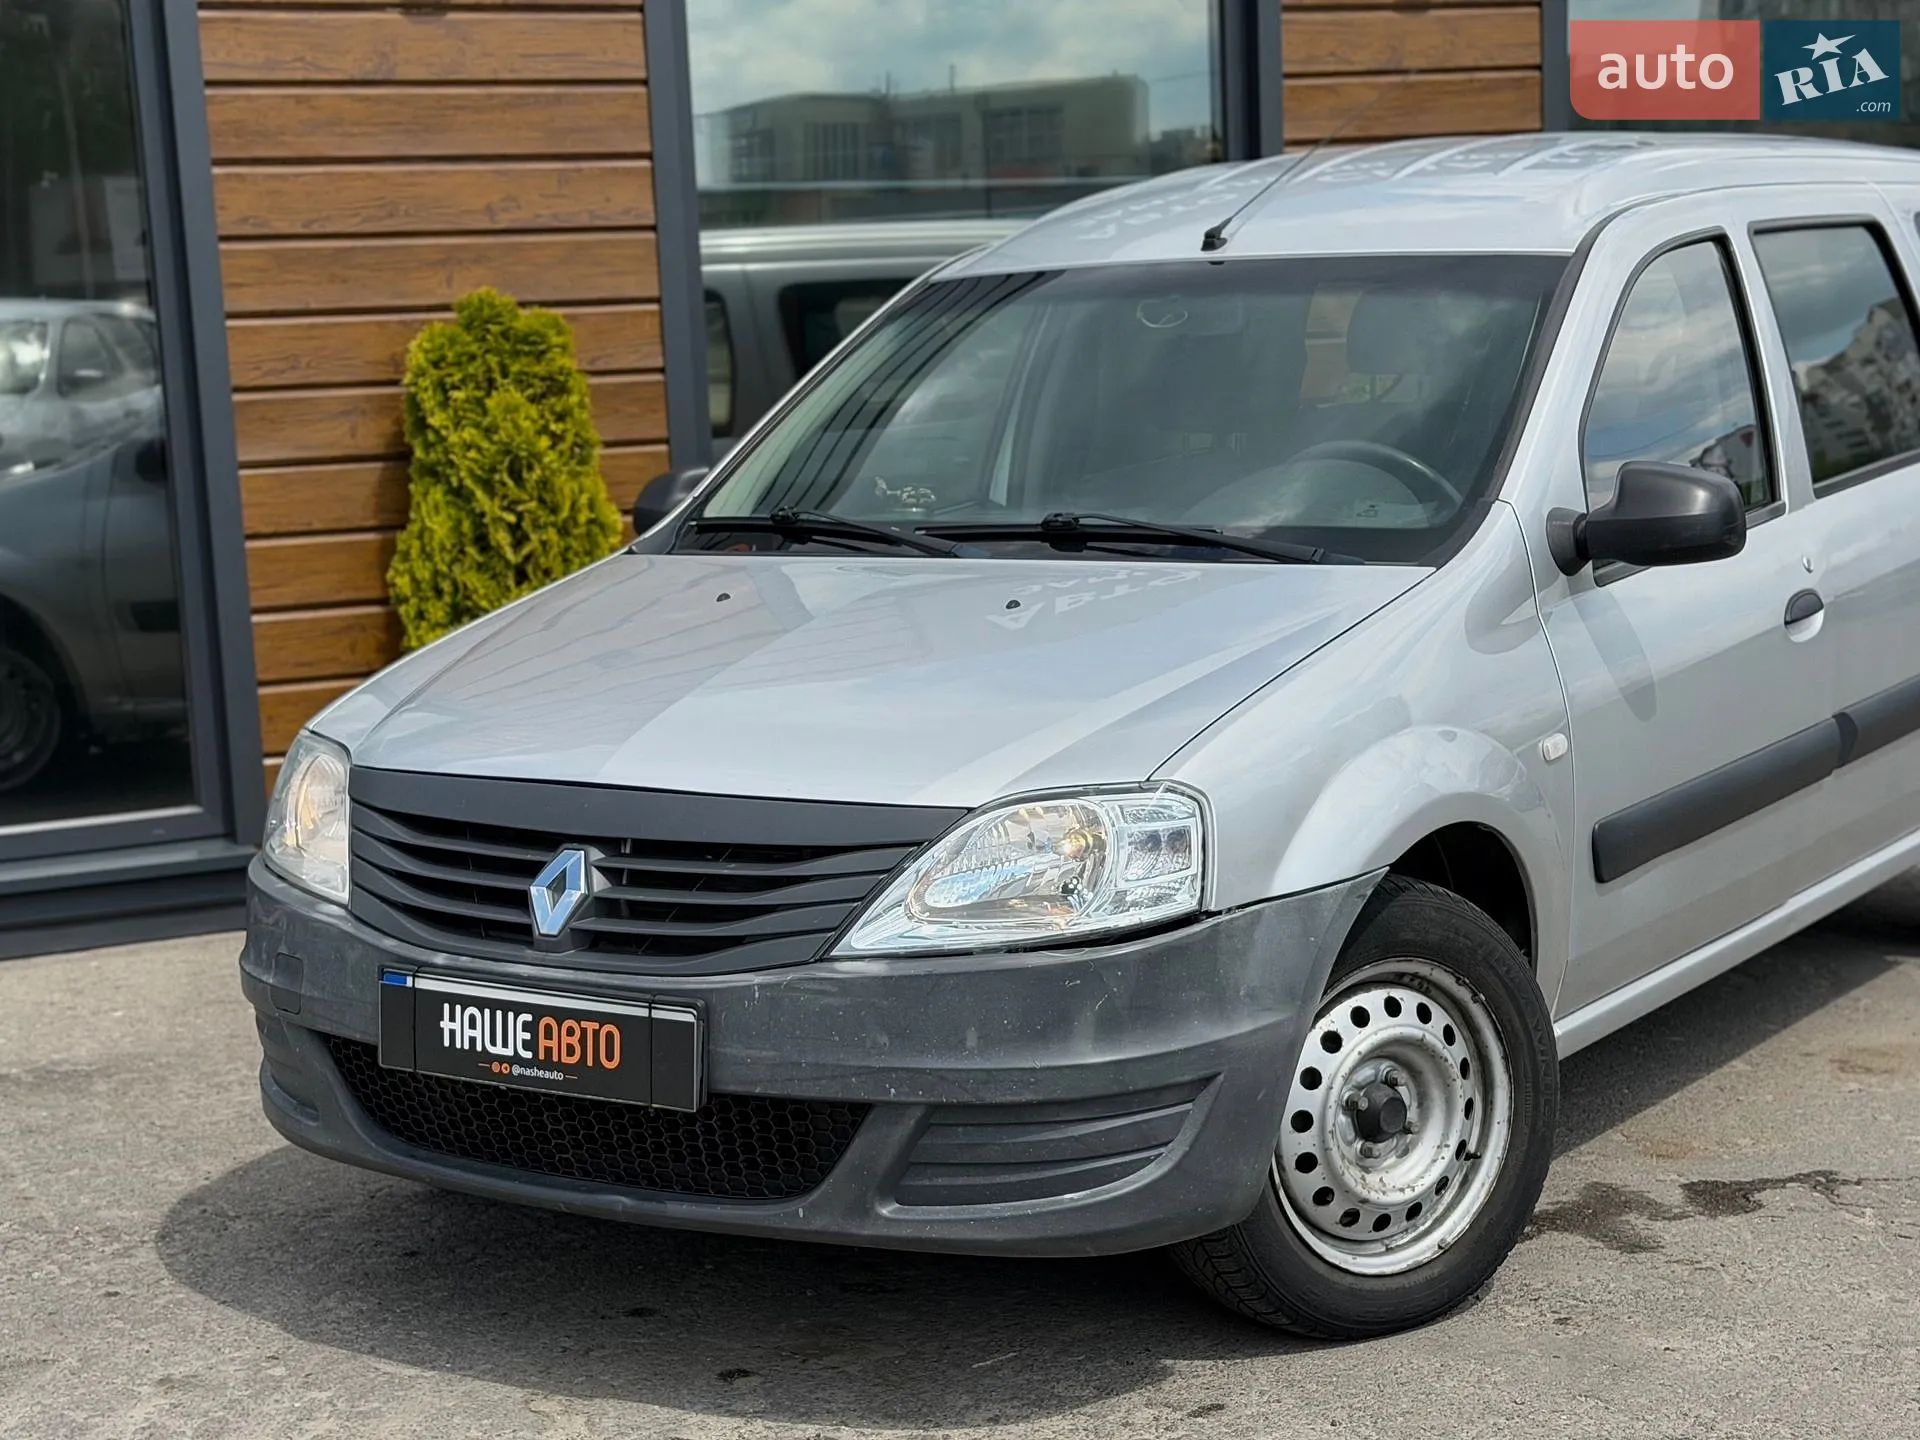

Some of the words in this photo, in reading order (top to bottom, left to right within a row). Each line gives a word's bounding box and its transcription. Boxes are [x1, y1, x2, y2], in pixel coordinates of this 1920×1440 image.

[440, 1003, 533, 1059] НАШЕ
[537, 1016, 621, 1070] АВТО
[511, 1063, 564, 1081] @nasheauto
